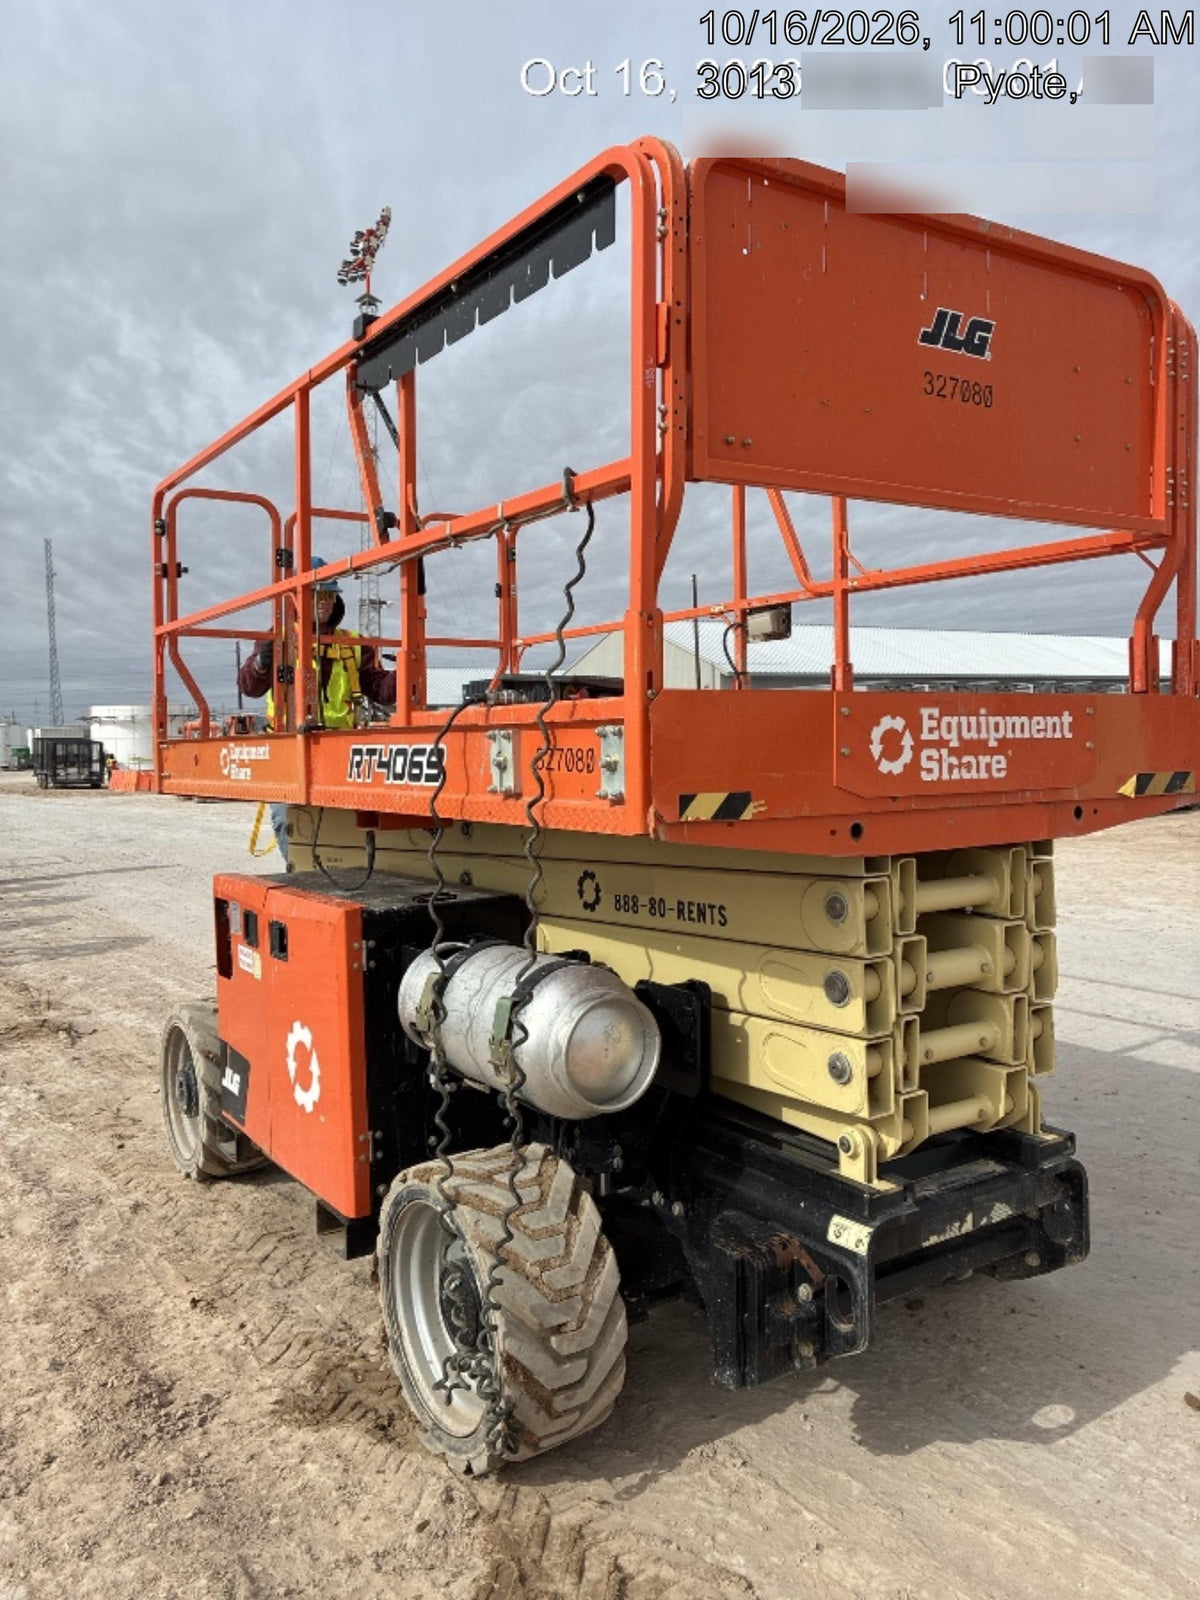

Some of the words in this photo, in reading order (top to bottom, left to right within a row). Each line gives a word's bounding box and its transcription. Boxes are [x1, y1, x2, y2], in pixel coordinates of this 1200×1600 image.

[917, 306, 996, 361] JLG
[923, 370, 994, 409] 327080
[919, 706, 1074, 748] Equipment
[346, 743, 448, 788] RT4069
[919, 747, 1008, 782] Share
[613, 893, 728, 928] 888-80-RENTS
[221, 1066, 241, 1096] JLG
